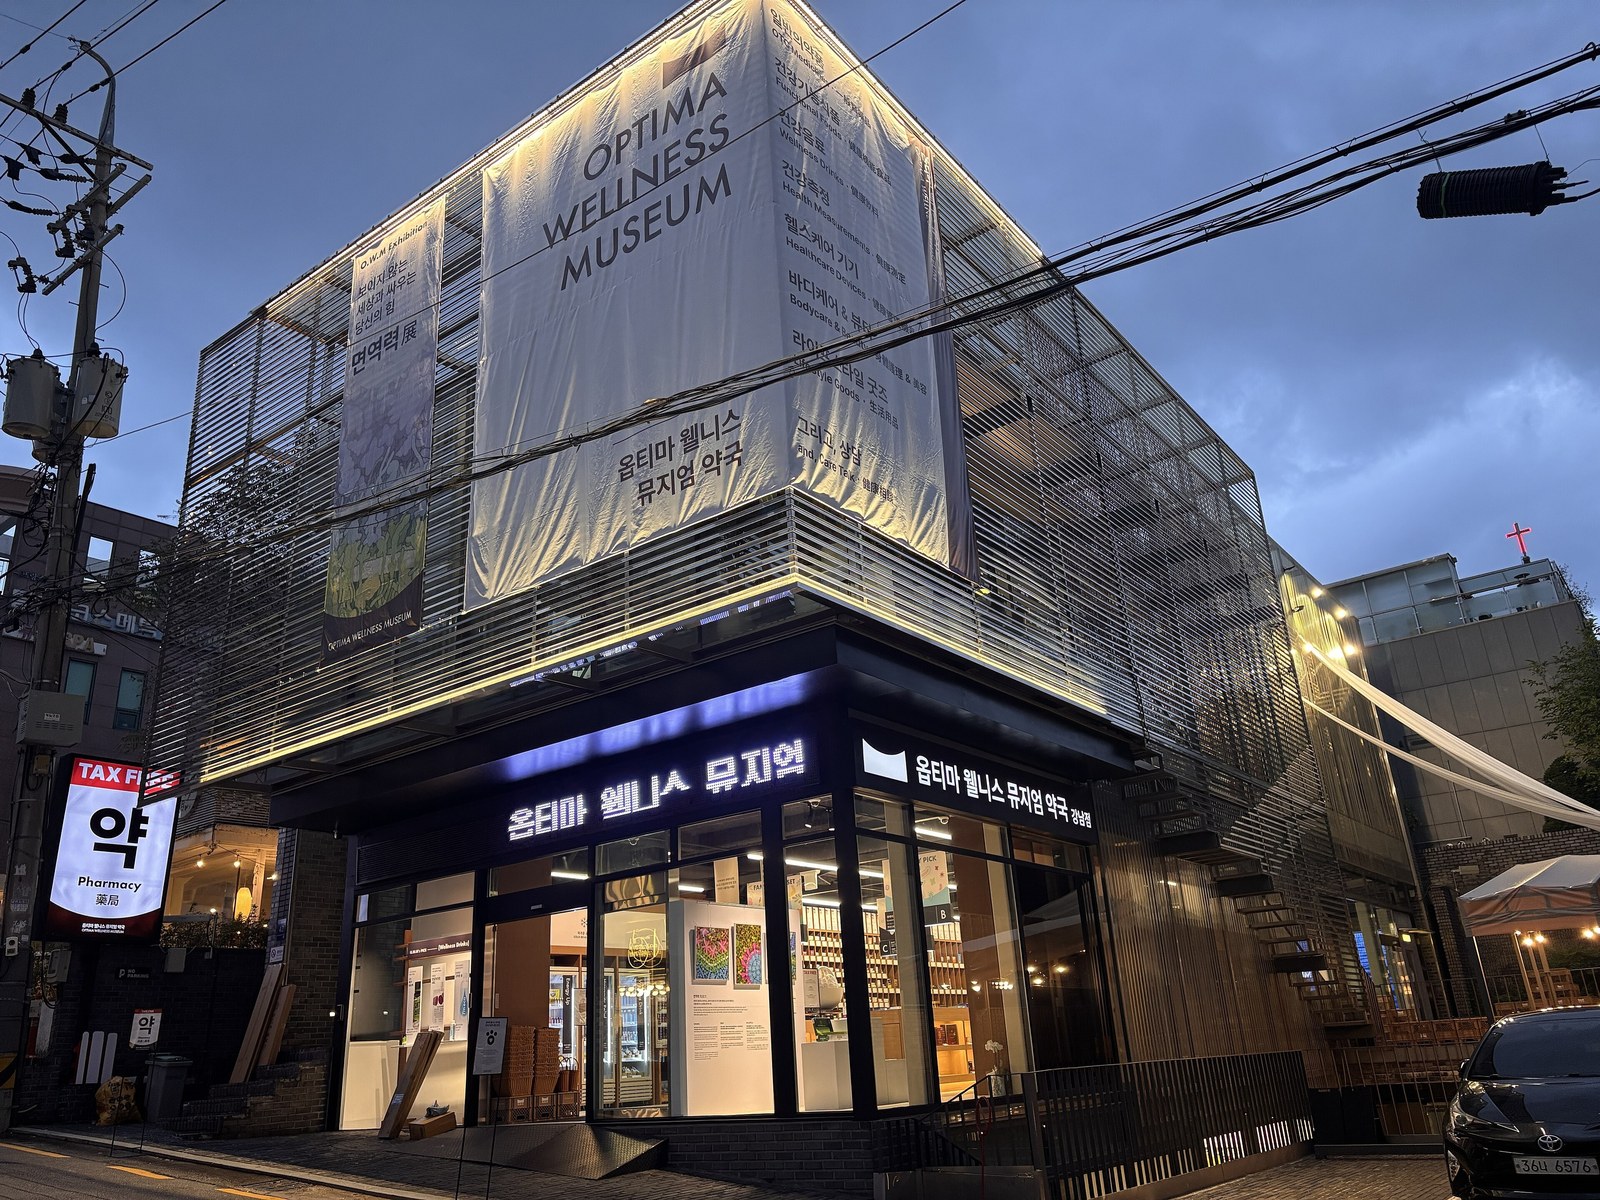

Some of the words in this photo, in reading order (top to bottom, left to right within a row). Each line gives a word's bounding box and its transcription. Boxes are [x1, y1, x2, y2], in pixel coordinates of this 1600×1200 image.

[770, 8, 825, 70] 일반의약품
[774, 56, 841, 127] 건강기능식품
[776, 76, 819, 117] Functional
[820, 111, 842, 140] Foods
[584, 71, 728, 181] OPTIMA
[778, 107, 826, 156] 건강음료
[542, 113, 730, 249] WELLNESS
[779, 127, 819, 164] Wellness
[820, 157, 845, 187] Drinks
[782, 159, 831, 207] 건강측정
[560, 162, 732, 291] MUSEUM
[783, 181, 813, 212] Health
[814, 203, 871, 256] Measurements
[360, 247, 386, 270] O.W.M
[388, 220, 428, 253] Exhibition
[784, 213, 835, 261] 헬스케어
[837, 251, 859, 280] 기기
[785, 236, 835, 275] Healthcare
[836, 269, 867, 300] Devices
[356, 288, 384, 316] 세상과
[386, 272, 417, 295] 싸우는
[358, 270, 386, 300] 보이지
[386, 259, 408, 278] 않는
[789, 270, 839, 316] 바디케어
[841, 305, 849, 322] &
[354, 306, 383, 336] 당신의
[385, 299, 396, 317] 힘
[789, 293, 833, 328] Bodycare
[834, 322, 841, 333] &
[834, 376, 860, 403] Goods
[869, 399, 899, 431] 生活用品
[867, 376, 889, 405] 굿즈
[904, 373, 912, 385] &
[617, 435, 676, 483] 옵티마
[680, 408, 742, 455] 웰니스
[797, 415, 837, 455] 그리고,
[839, 440, 862, 467] 상담
[637, 459, 696, 507] 뮤지엄
[701, 439, 743, 477] 약국
[819, 453, 838, 473] Care
[838, 461, 856, 482] Talk
[327, 635, 351, 652] OPTIMA
[351, 622, 383, 642] WELLNESS
[384, 609, 412, 629] MUSEUM
[78, 762, 122, 784] TAX
[916, 755, 961, 794] 옵티마
[963, 768, 1005, 803] 웰니스
[1006, 781, 1044, 816] 뮤지엄
[1045, 793, 1069, 823] 약국
[1070, 808, 1092, 829] 강남점
[90, 807, 150, 870] 약
[922, 855, 937, 863] PICK
[77, 876, 142, 893] Pharmacy
[940, 909, 947, 920] B
[882, 944, 889, 953] C
[139, 1015, 155, 1035] 약
[1555, 1160, 1591, 1173] 6576
